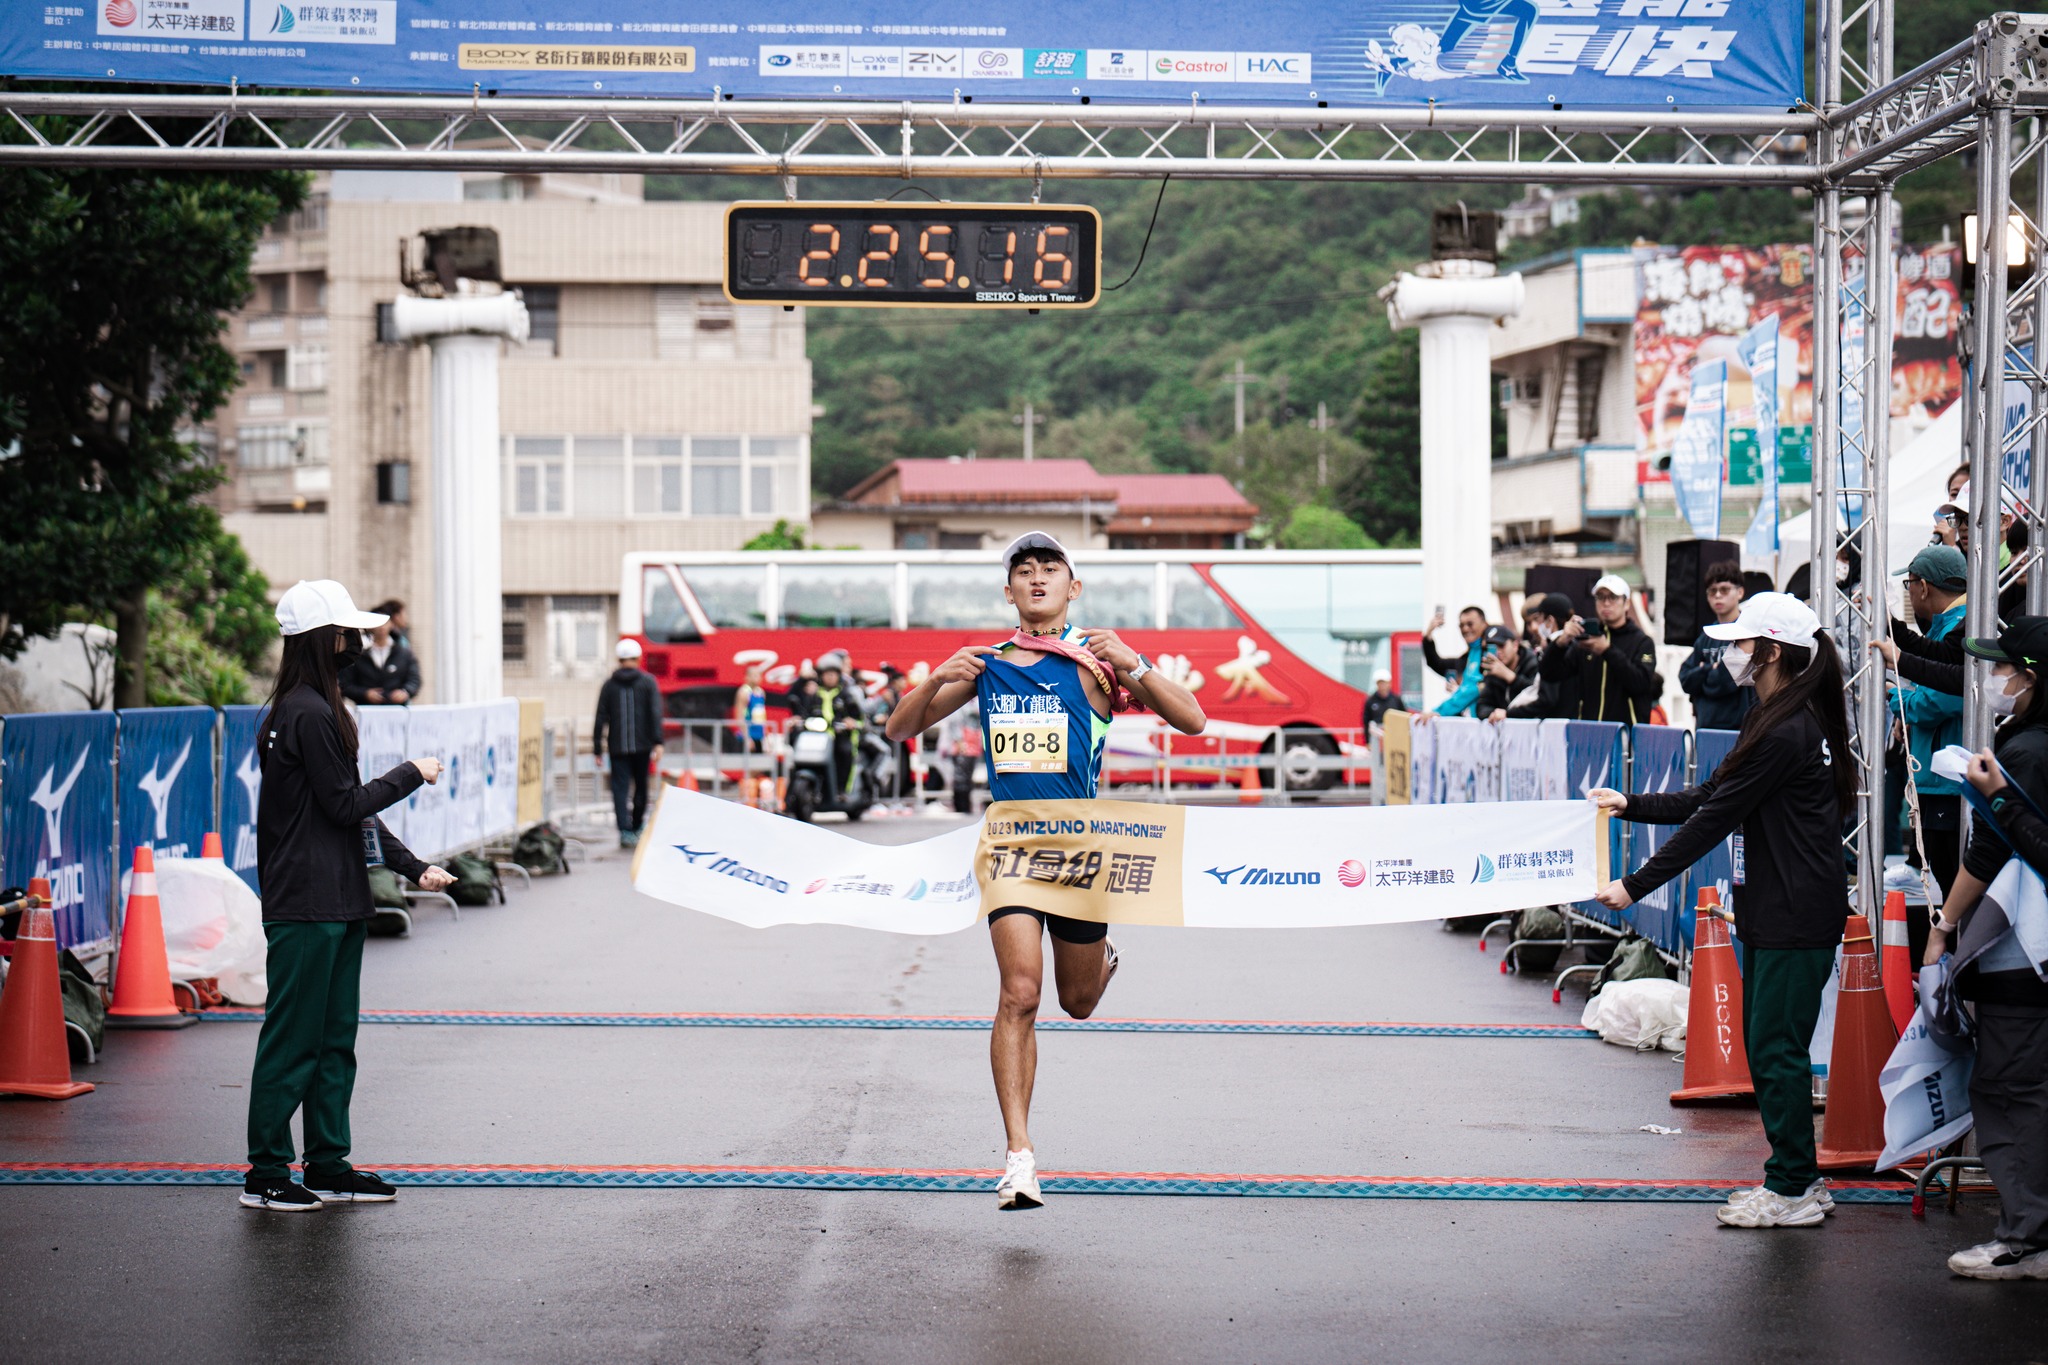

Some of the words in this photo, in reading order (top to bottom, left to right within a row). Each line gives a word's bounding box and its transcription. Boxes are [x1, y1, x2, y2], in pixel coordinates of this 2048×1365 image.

[147, 14, 235, 32] 太平洋建設
[299, 6, 378, 24] 群策翡翠灣
[467, 49, 530, 58] BODY
[535, 50, 687, 66] 名衍行銷股份有限公司
[797, 52, 841, 62] 新竹物流
[909, 53, 957, 63] ZIV
[1034, 52, 1076, 68] 舒跑
[1175, 60, 1228, 73] Castrol
[1248, 58, 1299, 73] HAC
[975, 291, 1016, 302] SEIKO
[1017, 292, 1048, 303] Sports
[1049, 293, 1076, 302] Timer
[994, 732, 1060, 754] 018-8
[987, 821, 1012, 836] 2023
[1013, 819, 1086, 835] MIZUNO
[1089, 819, 1149, 839] MARATHON
[1149, 824, 1167, 833] RELAY
[1149, 831, 1163, 839] RACE
[1375, 858, 1413, 868] 太平洋集團
[1498, 848, 1574, 870] 群策翡翠灣
[989, 845, 1103, 890] 社會組
[1537, 867, 1574, 880] 溫泉飯店
[1239, 867, 1321, 885] MIZUNO
[1375, 868, 1455, 887] 太平洋建設
[1714, 983, 1732, 1065] BODY
